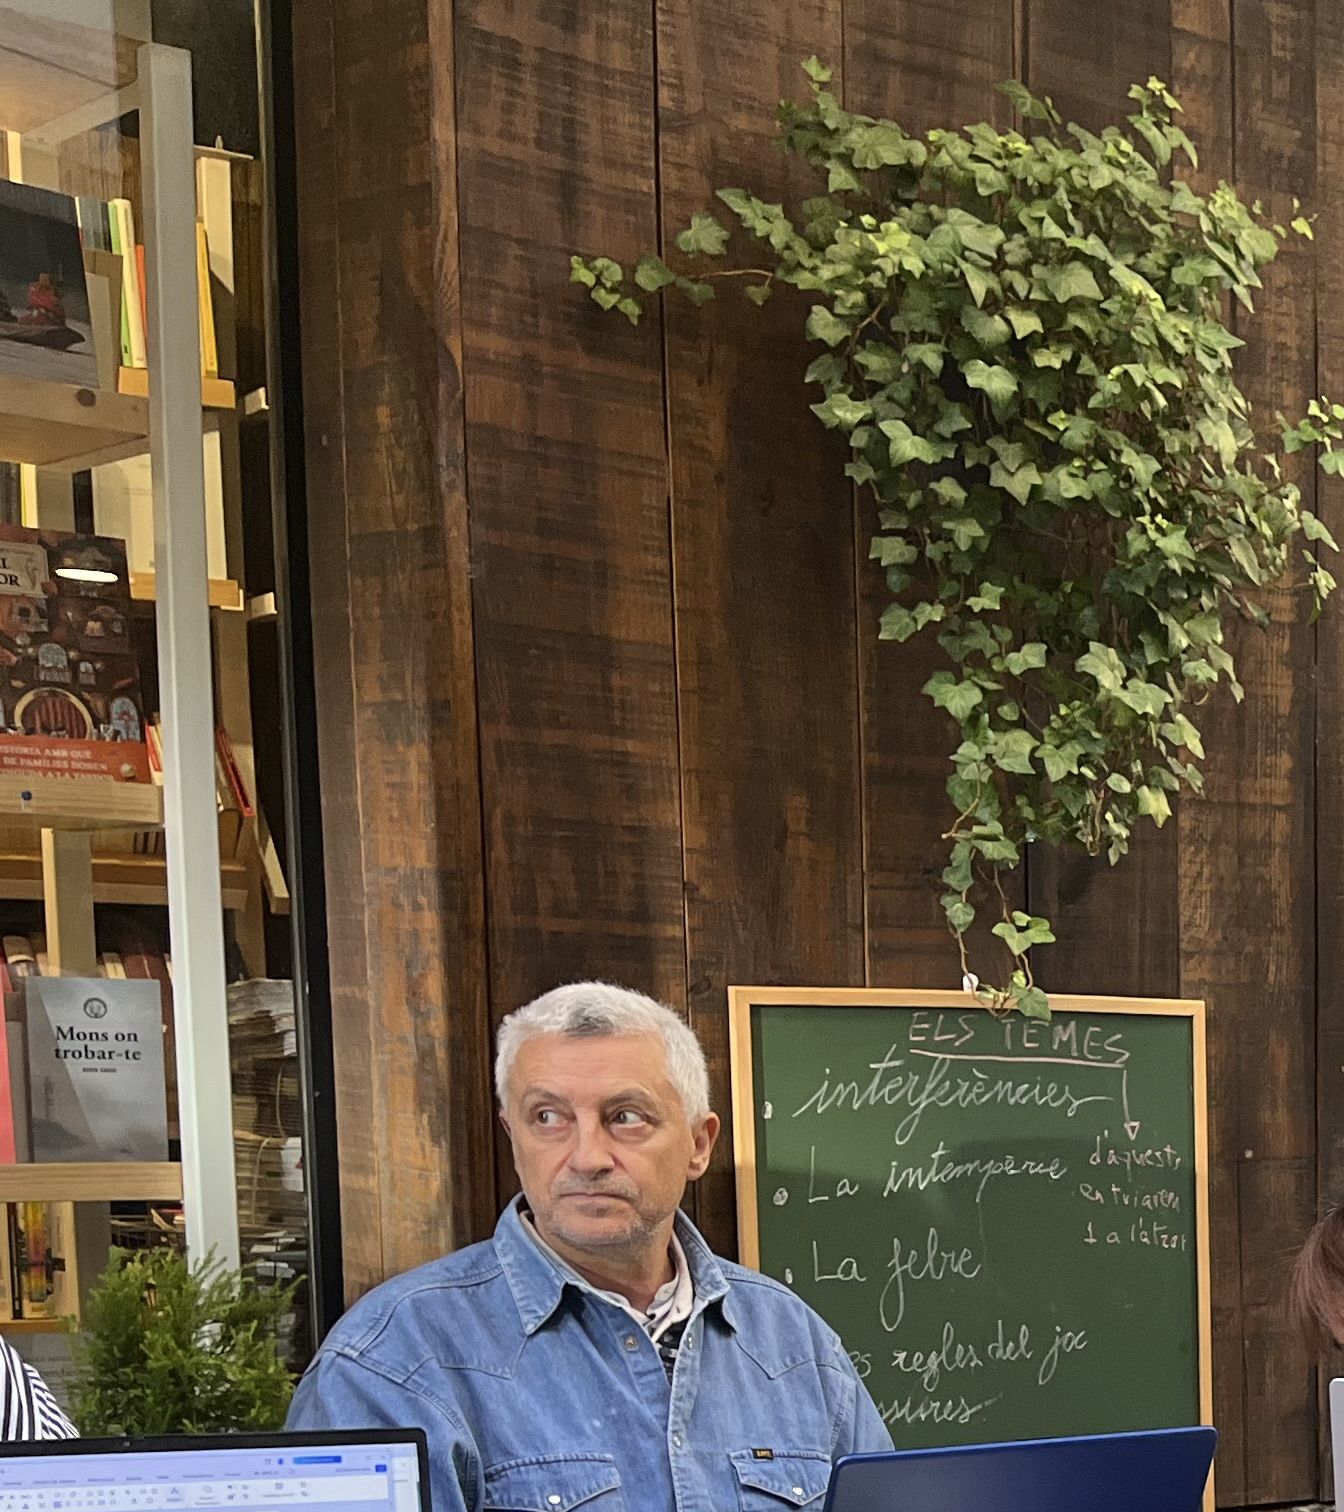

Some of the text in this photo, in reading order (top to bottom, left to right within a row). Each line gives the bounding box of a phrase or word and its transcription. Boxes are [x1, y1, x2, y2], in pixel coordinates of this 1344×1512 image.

[54, 1044, 142, 1061] trobar-te
[56, 1025, 139, 1043] Mons on
[909, 1012, 1131, 1065] ELS TEMES
[792, 1044, 1115, 1144] interferències
[809, 1145, 859, 1203] La
[1084, 1222, 1097, 1244] 1
[1106, 1231, 1121, 1245] a
[812, 1227, 982, 1332] La febre
[891, 1321, 983, 1392] regles
[988, 1319, 1033, 1361] del
[1039, 1325, 1088, 1386] joc
